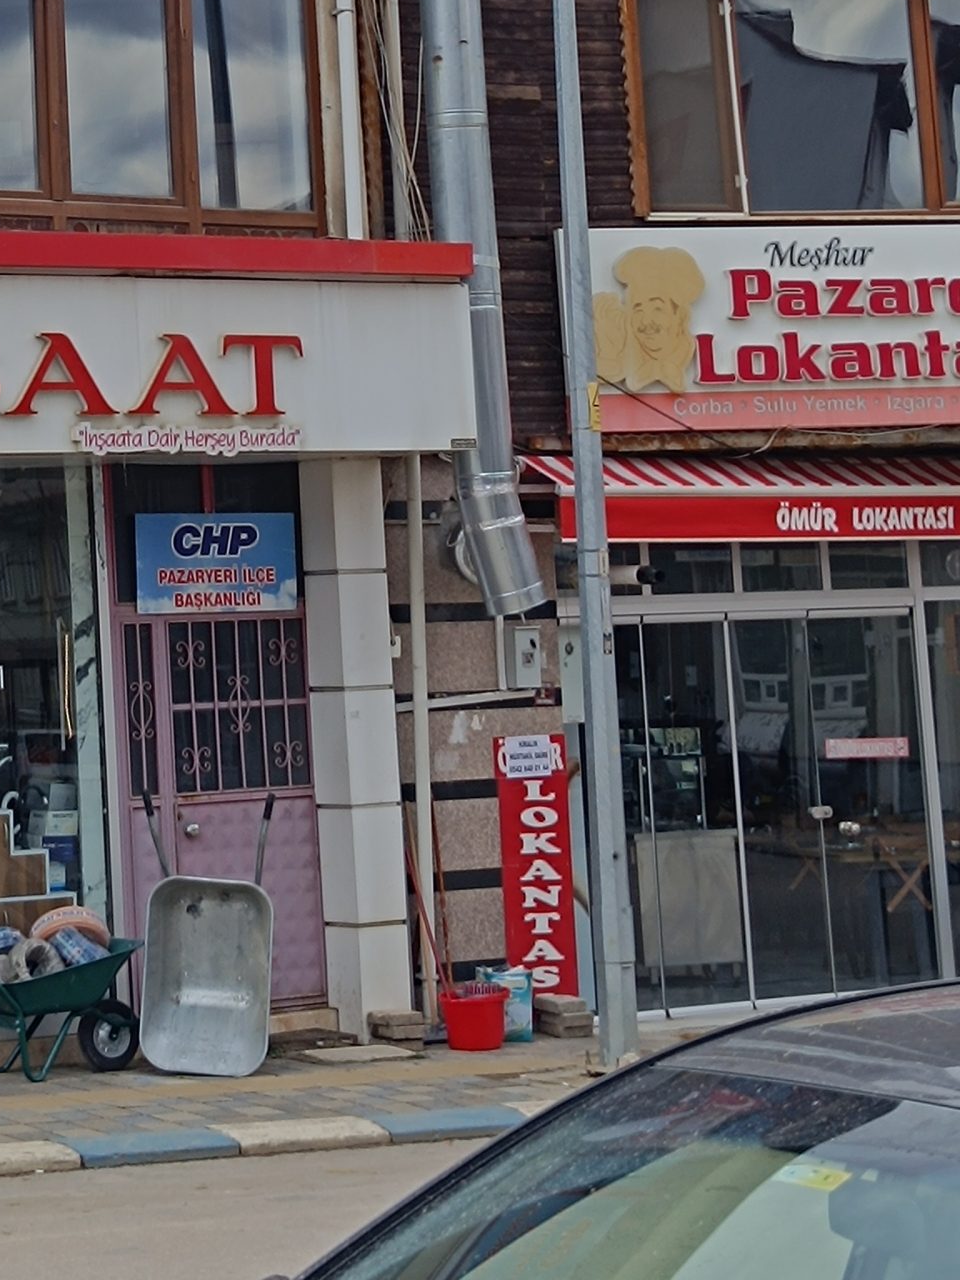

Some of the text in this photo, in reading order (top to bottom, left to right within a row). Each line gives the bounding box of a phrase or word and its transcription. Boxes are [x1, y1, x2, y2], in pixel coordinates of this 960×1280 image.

[764, 237, 874, 271] Meşhur
[695, 330, 960, 385] Lokant
[753, 396, 797, 414] Sulu
[803, 395, 866, 412] Yemek
[776, 502, 954, 533] ÖMÜR LOKANTASI
[171, 523, 259, 559] CHP
[158, 563, 276, 588] PAZARYERİ İLÇE
[174, 587, 262, 611] BAŞKANLIĞI
[520, 780, 564, 996] LOKANTAS
